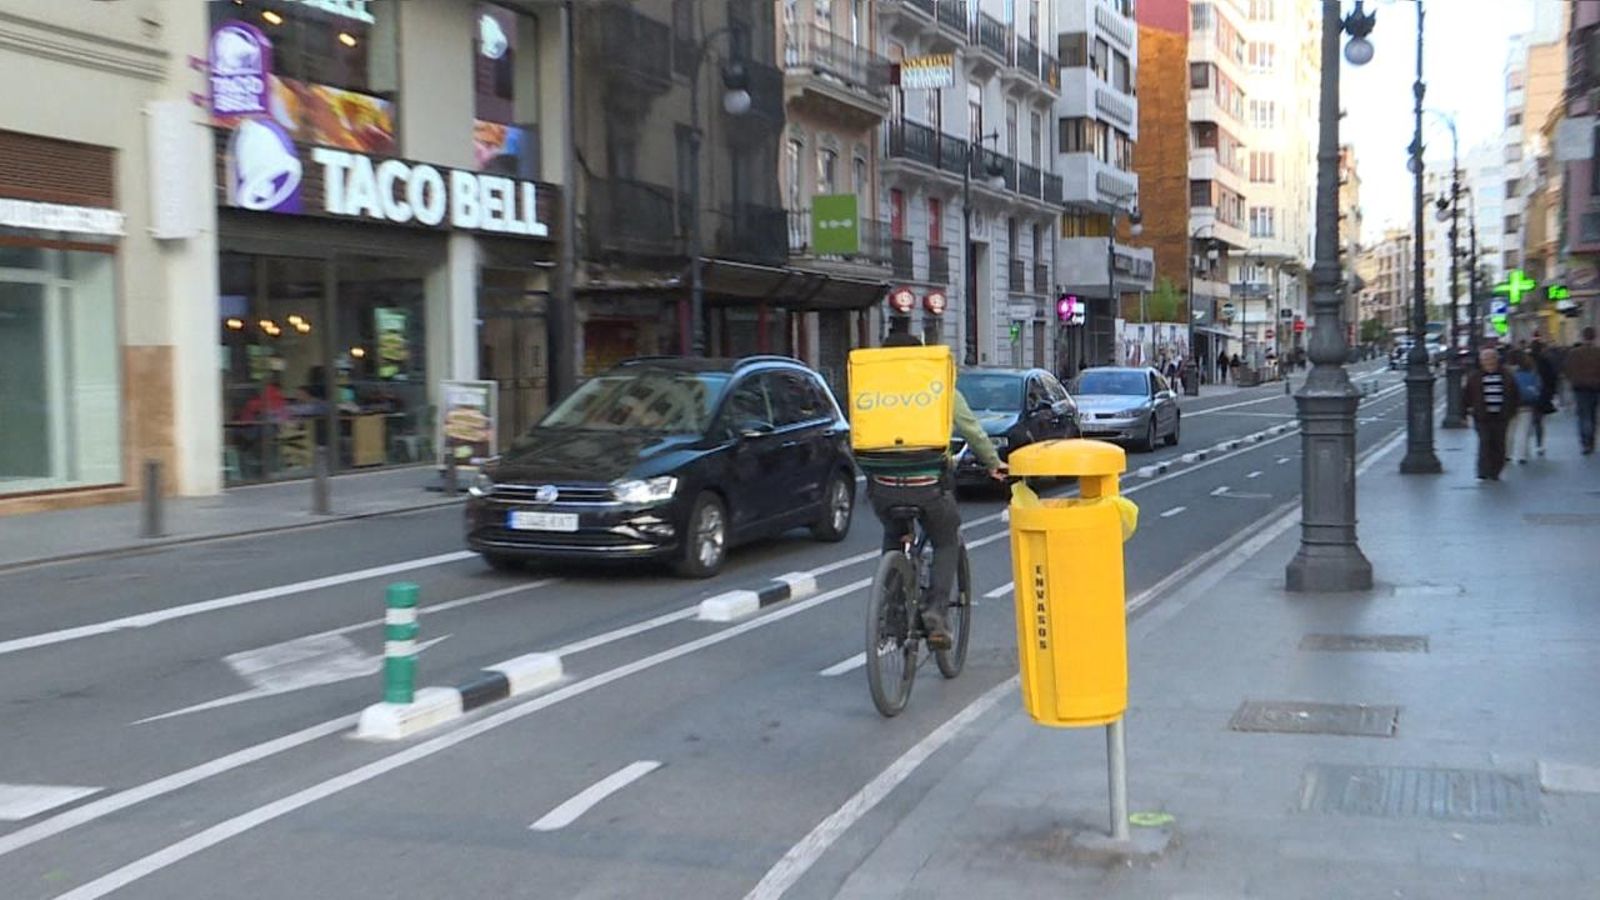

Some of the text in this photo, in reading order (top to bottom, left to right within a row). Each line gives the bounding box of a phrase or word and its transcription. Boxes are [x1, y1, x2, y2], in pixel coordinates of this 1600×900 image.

[312, 147, 548, 237] TACO BELL
[856, 391, 931, 410] Glovo
[1035, 565, 1047, 650] ENVASOS
